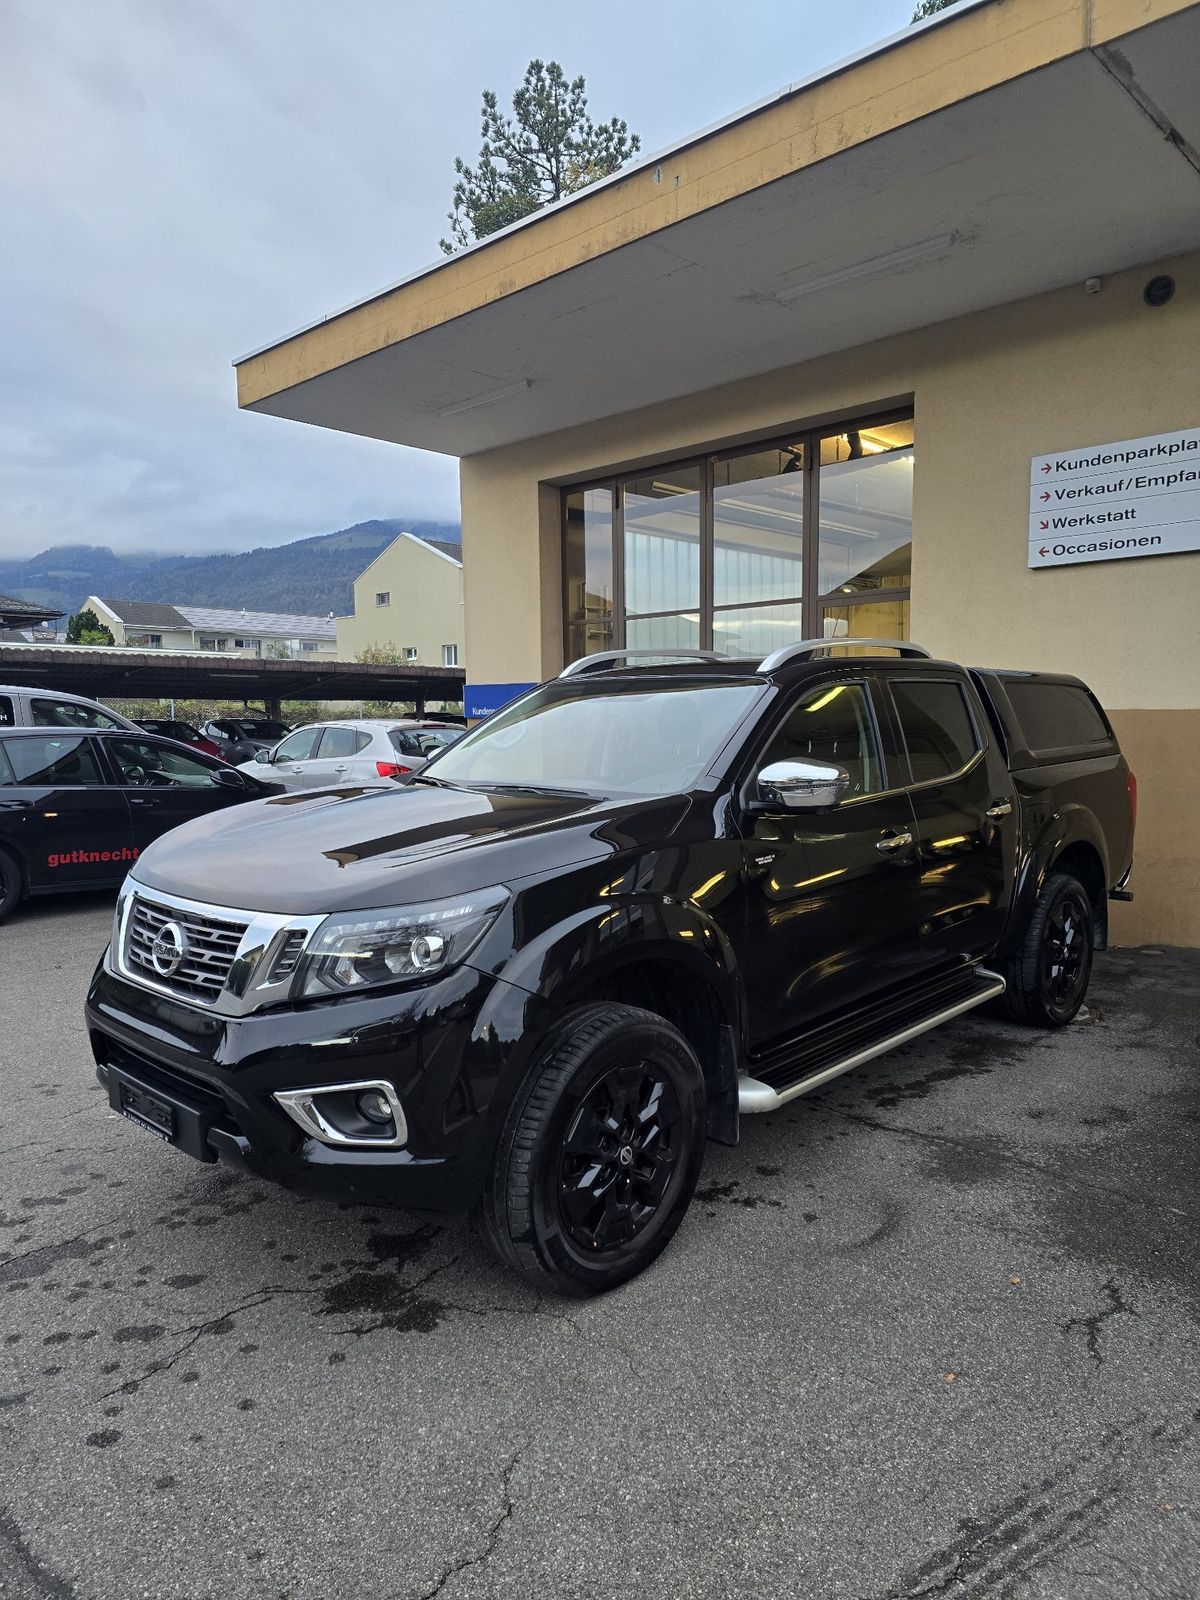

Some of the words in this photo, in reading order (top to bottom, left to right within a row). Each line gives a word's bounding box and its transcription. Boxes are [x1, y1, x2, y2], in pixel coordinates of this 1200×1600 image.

[1055, 439, 1200, 473] Kundenparkpla
[1054, 470, 1200, 500] Verkauf/Empfa
[1052, 508, 1137, 529] Werkstatt
[1052, 535, 1162, 556] Occasionen
[48, 848, 139, 867] gutknecht
